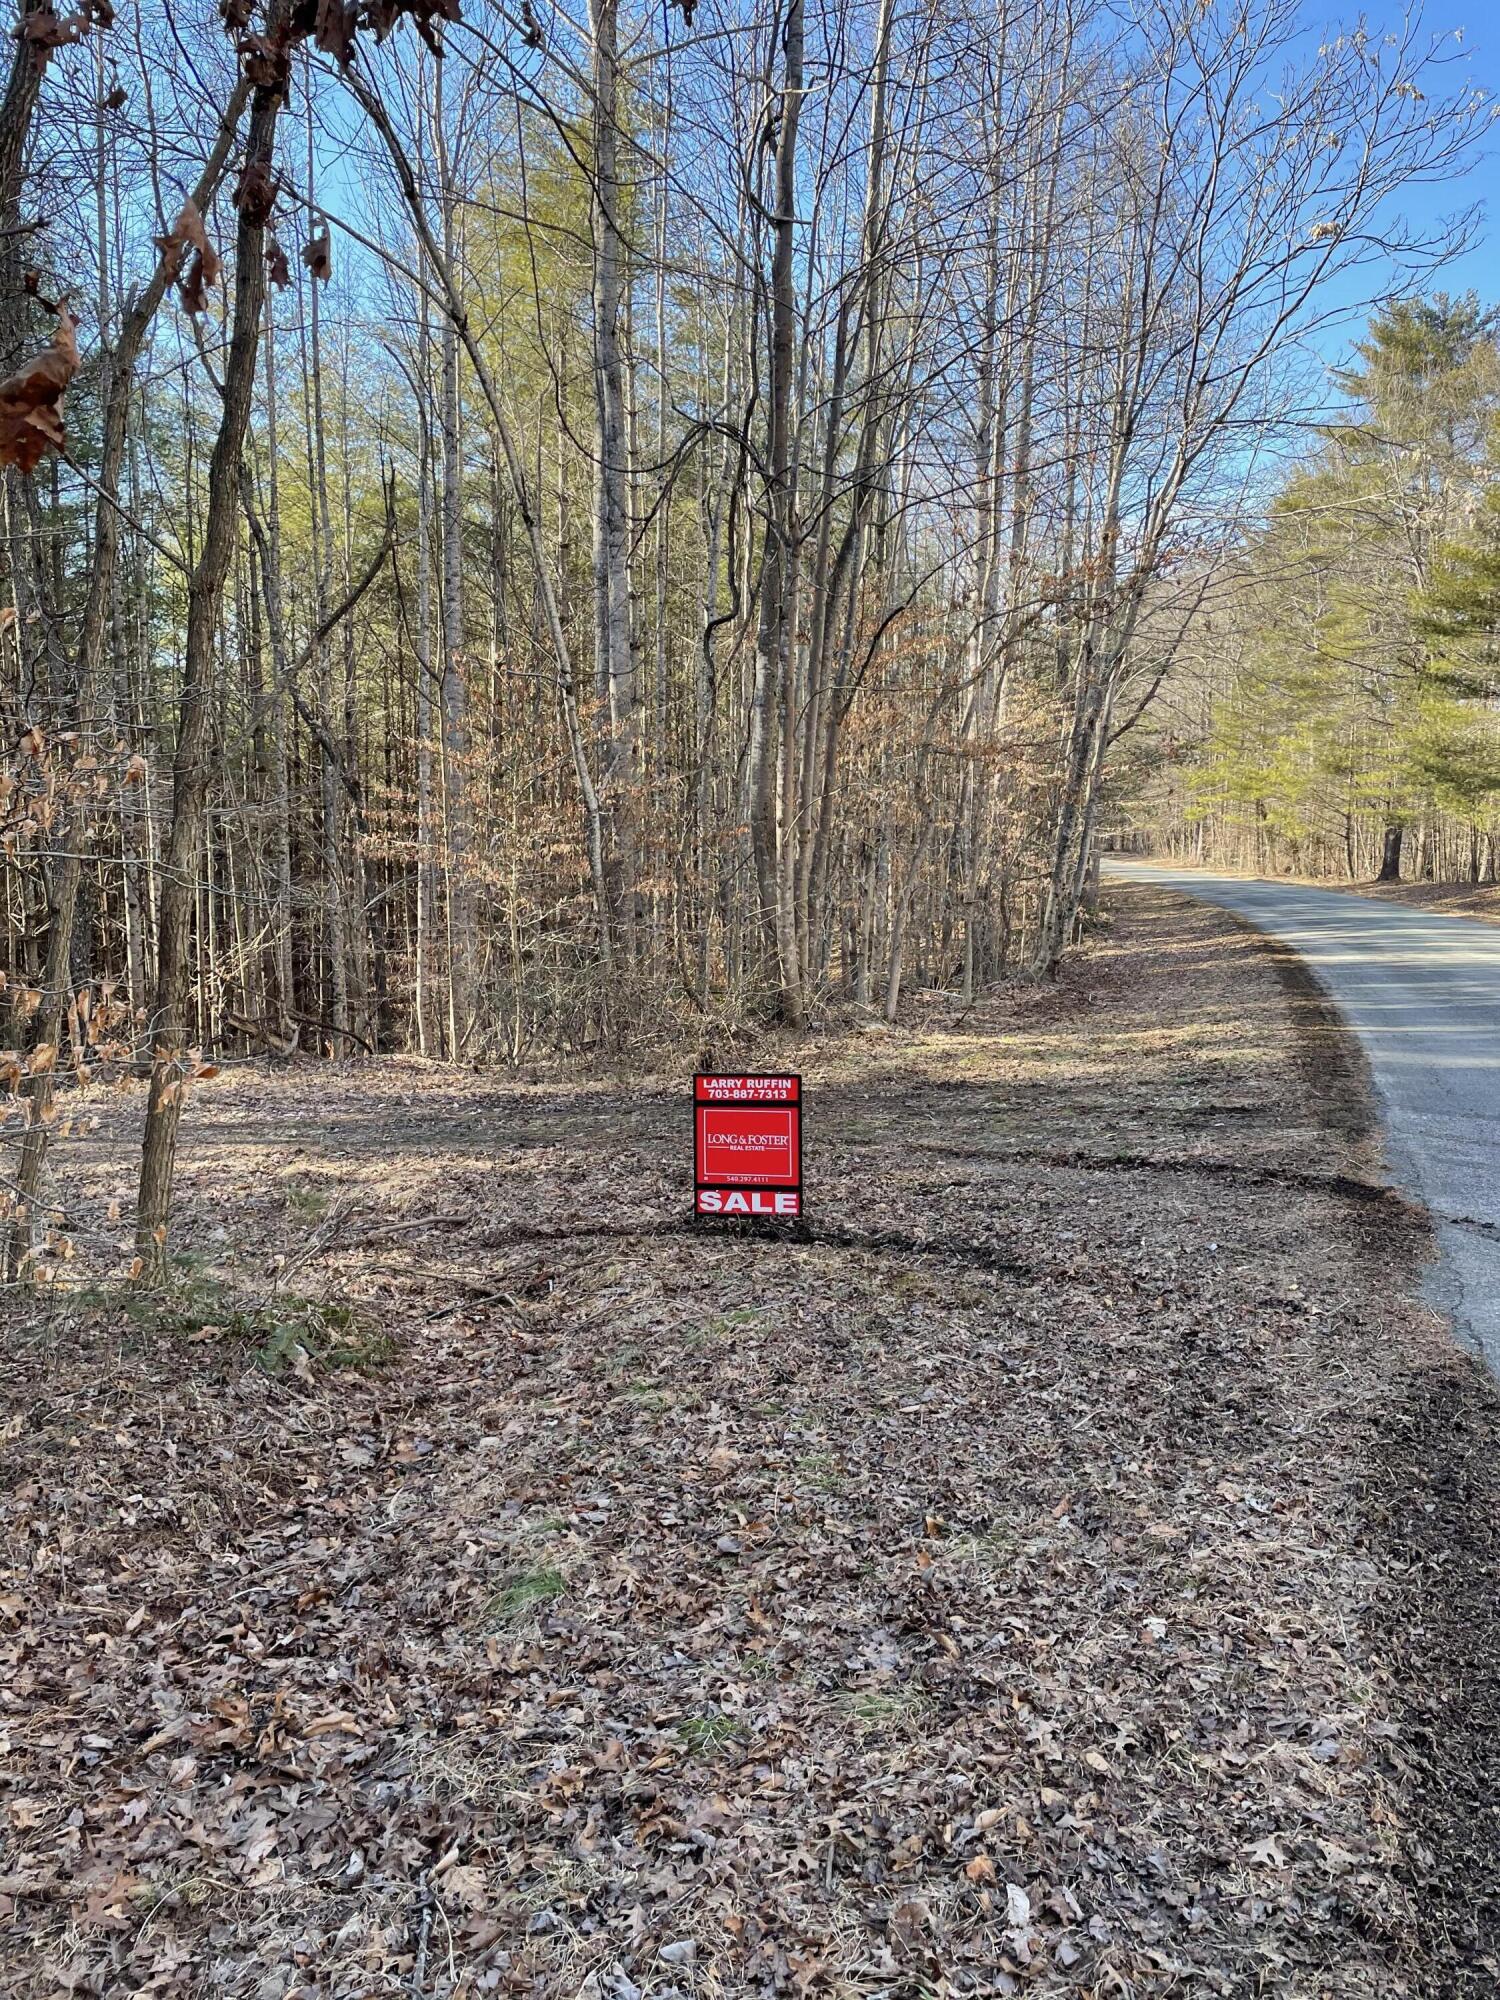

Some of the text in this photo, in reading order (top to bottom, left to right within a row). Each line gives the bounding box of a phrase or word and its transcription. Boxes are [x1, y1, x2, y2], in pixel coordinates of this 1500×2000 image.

[703, 1079, 792, 1089] LARRY RUFFIN
[708, 1089, 787, 1099] 703-887-7313
[707, 1133, 788, 1146] LONG & FOSTER
[699, 1191, 798, 1214] SALE
